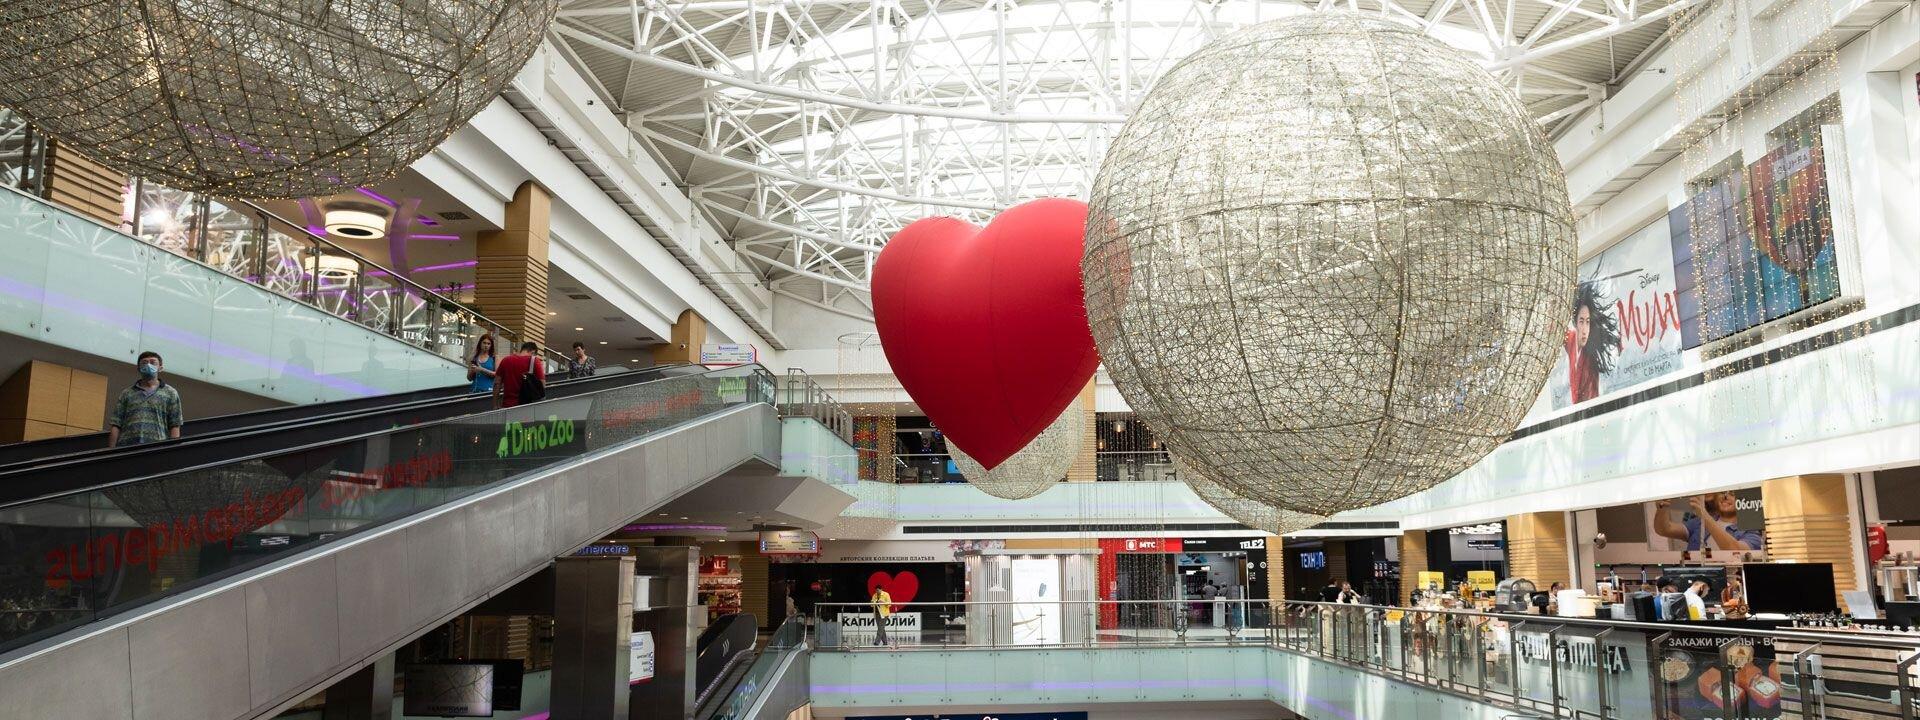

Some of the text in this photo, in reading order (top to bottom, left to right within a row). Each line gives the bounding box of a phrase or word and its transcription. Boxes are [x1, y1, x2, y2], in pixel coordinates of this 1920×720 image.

[1617, 290, 1680, 356] МУЛА
[512, 415, 574, 456] Dino Zoo
[1240, 539, 1265, 549] TELE2
[842, 615, 916, 627] КАПИОЛИЙ
[1669, 637, 1713, 647] ЗАКАЖИ
[1716, 637, 1755, 647] РОЛЫ
